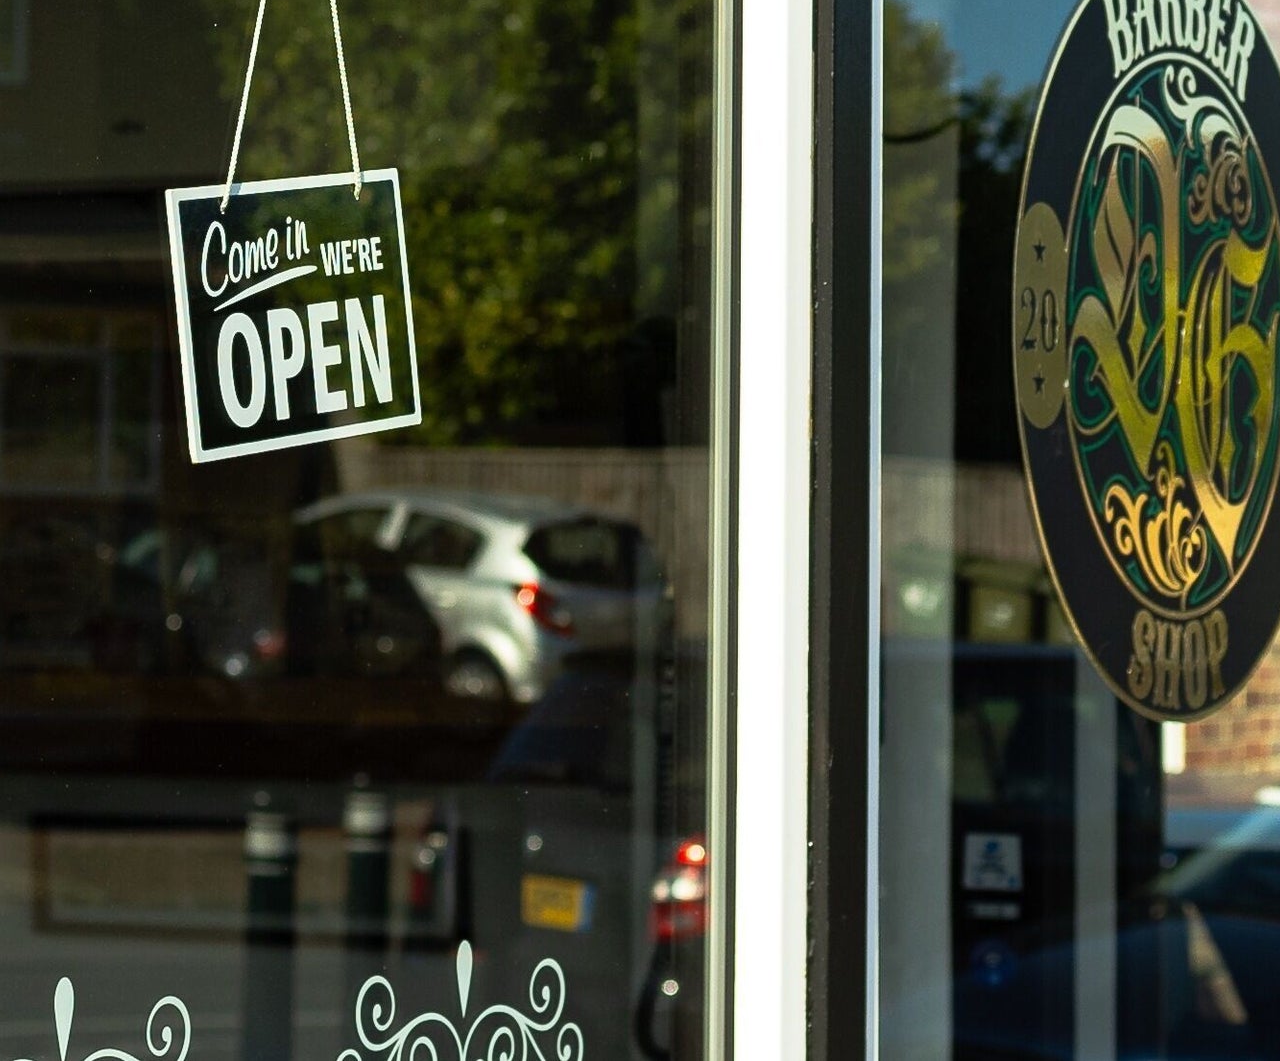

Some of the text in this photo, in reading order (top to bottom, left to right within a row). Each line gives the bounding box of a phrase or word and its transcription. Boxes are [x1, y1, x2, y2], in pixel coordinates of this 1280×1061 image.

[201, 216, 384, 298] Come in WE'RE
[217, 294, 393, 428] OPEN
[1020, 287, 1060, 353] 20
[1126, 608, 1229, 712] SHOP
